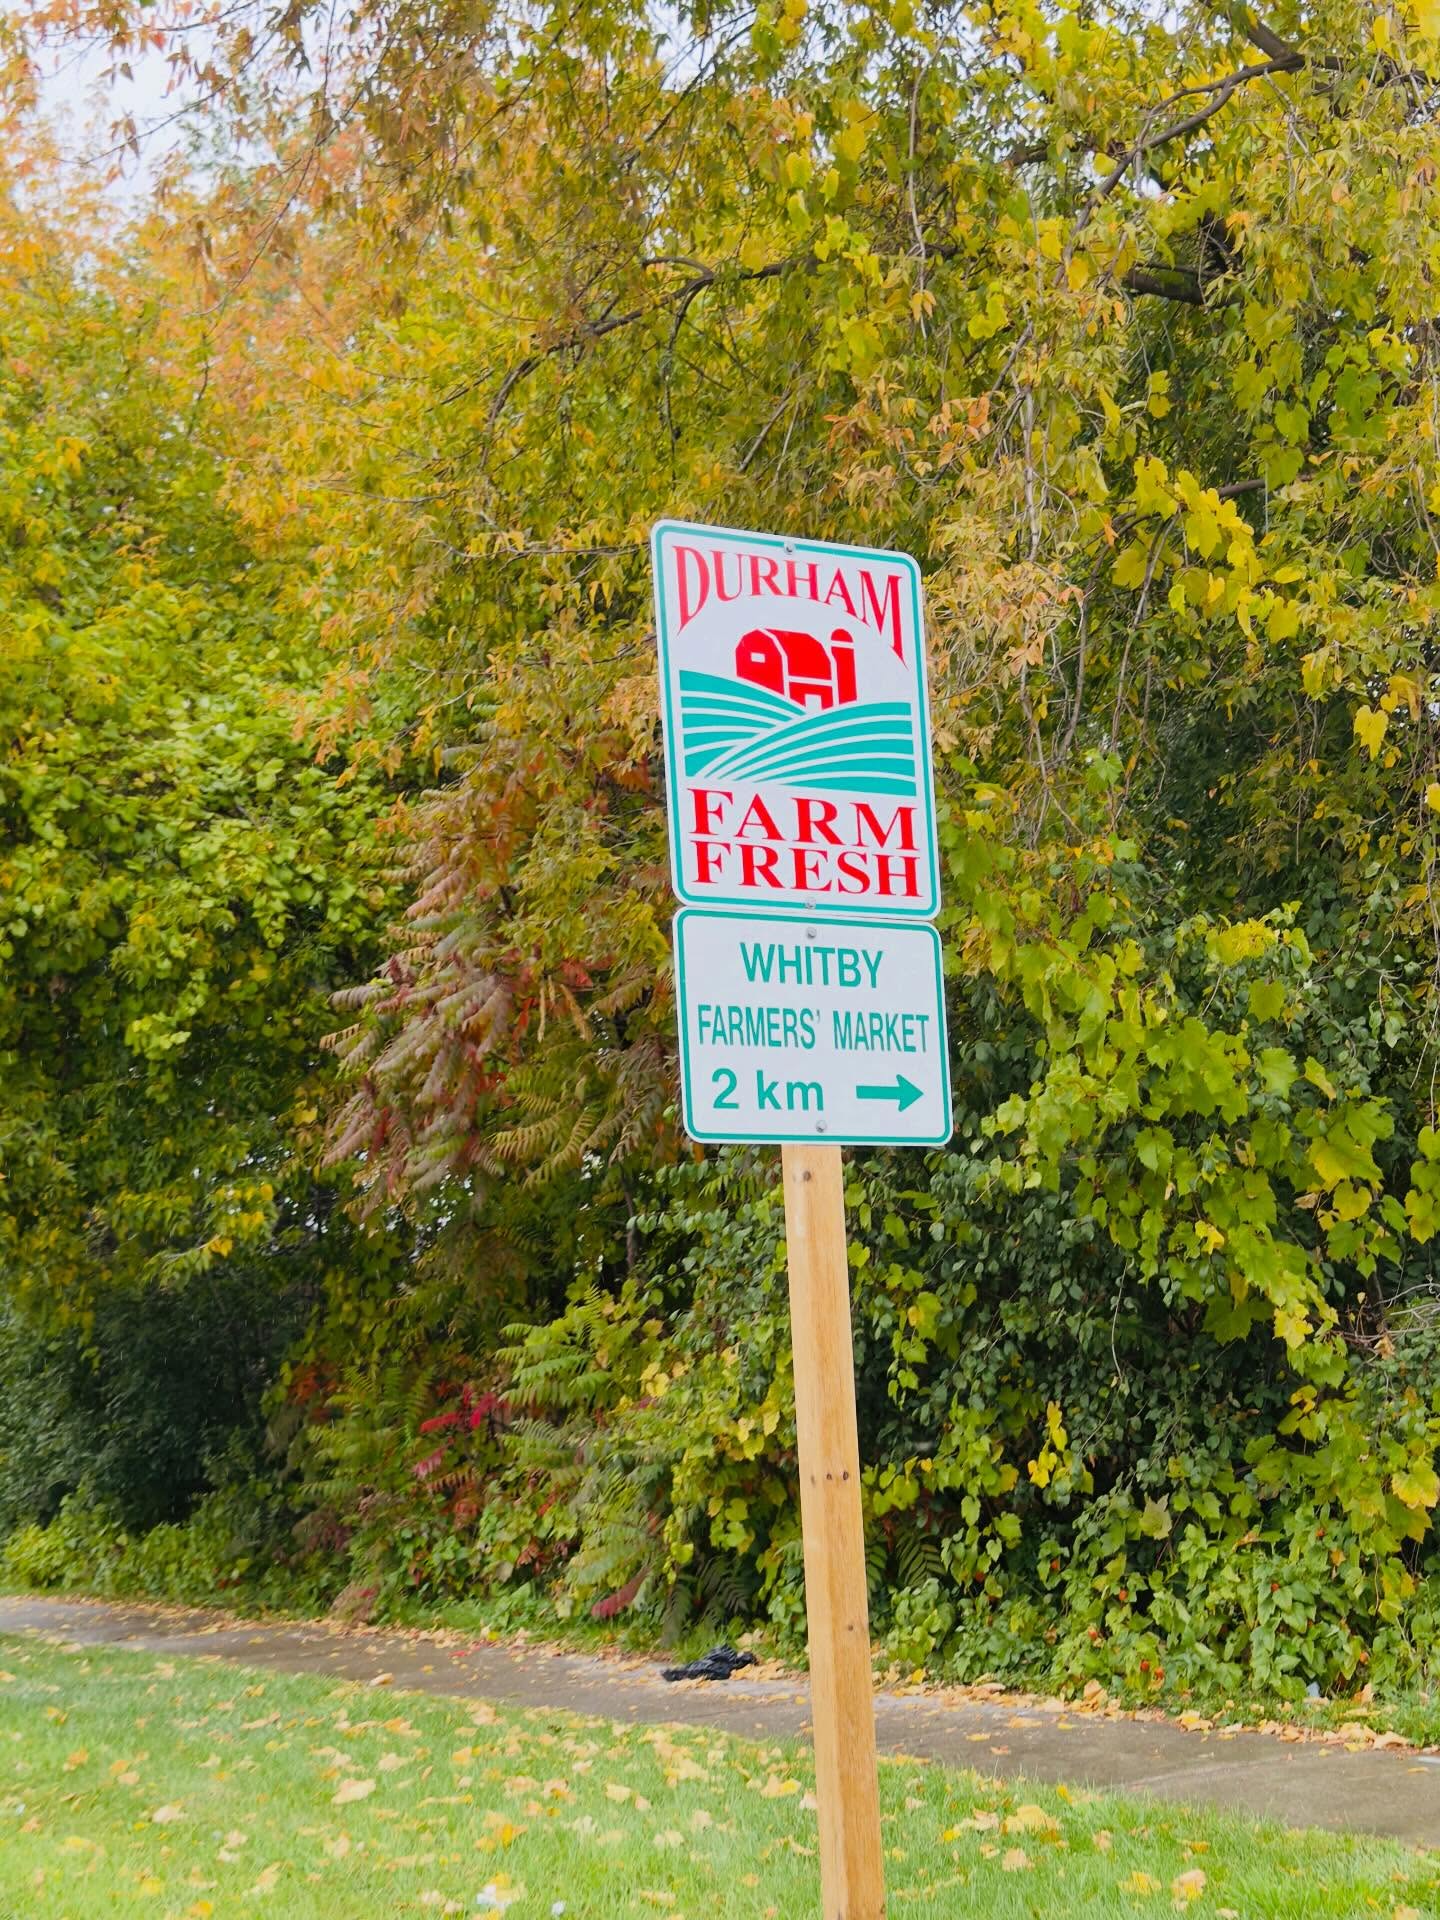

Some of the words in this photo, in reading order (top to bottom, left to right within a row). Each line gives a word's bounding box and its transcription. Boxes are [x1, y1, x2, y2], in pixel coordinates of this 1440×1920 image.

[673, 545, 908, 668] DURHAM
[688, 788, 919, 852] FARM
[692, 839, 922, 898] FRESH
[739, 942, 885, 990] WHITBY
[697, 1003, 821, 1051] FARMERS'
[832, 1009, 930, 1055] MARKET
[711, 1067, 741, 1111] 2
[756, 1068, 826, 1113] km
